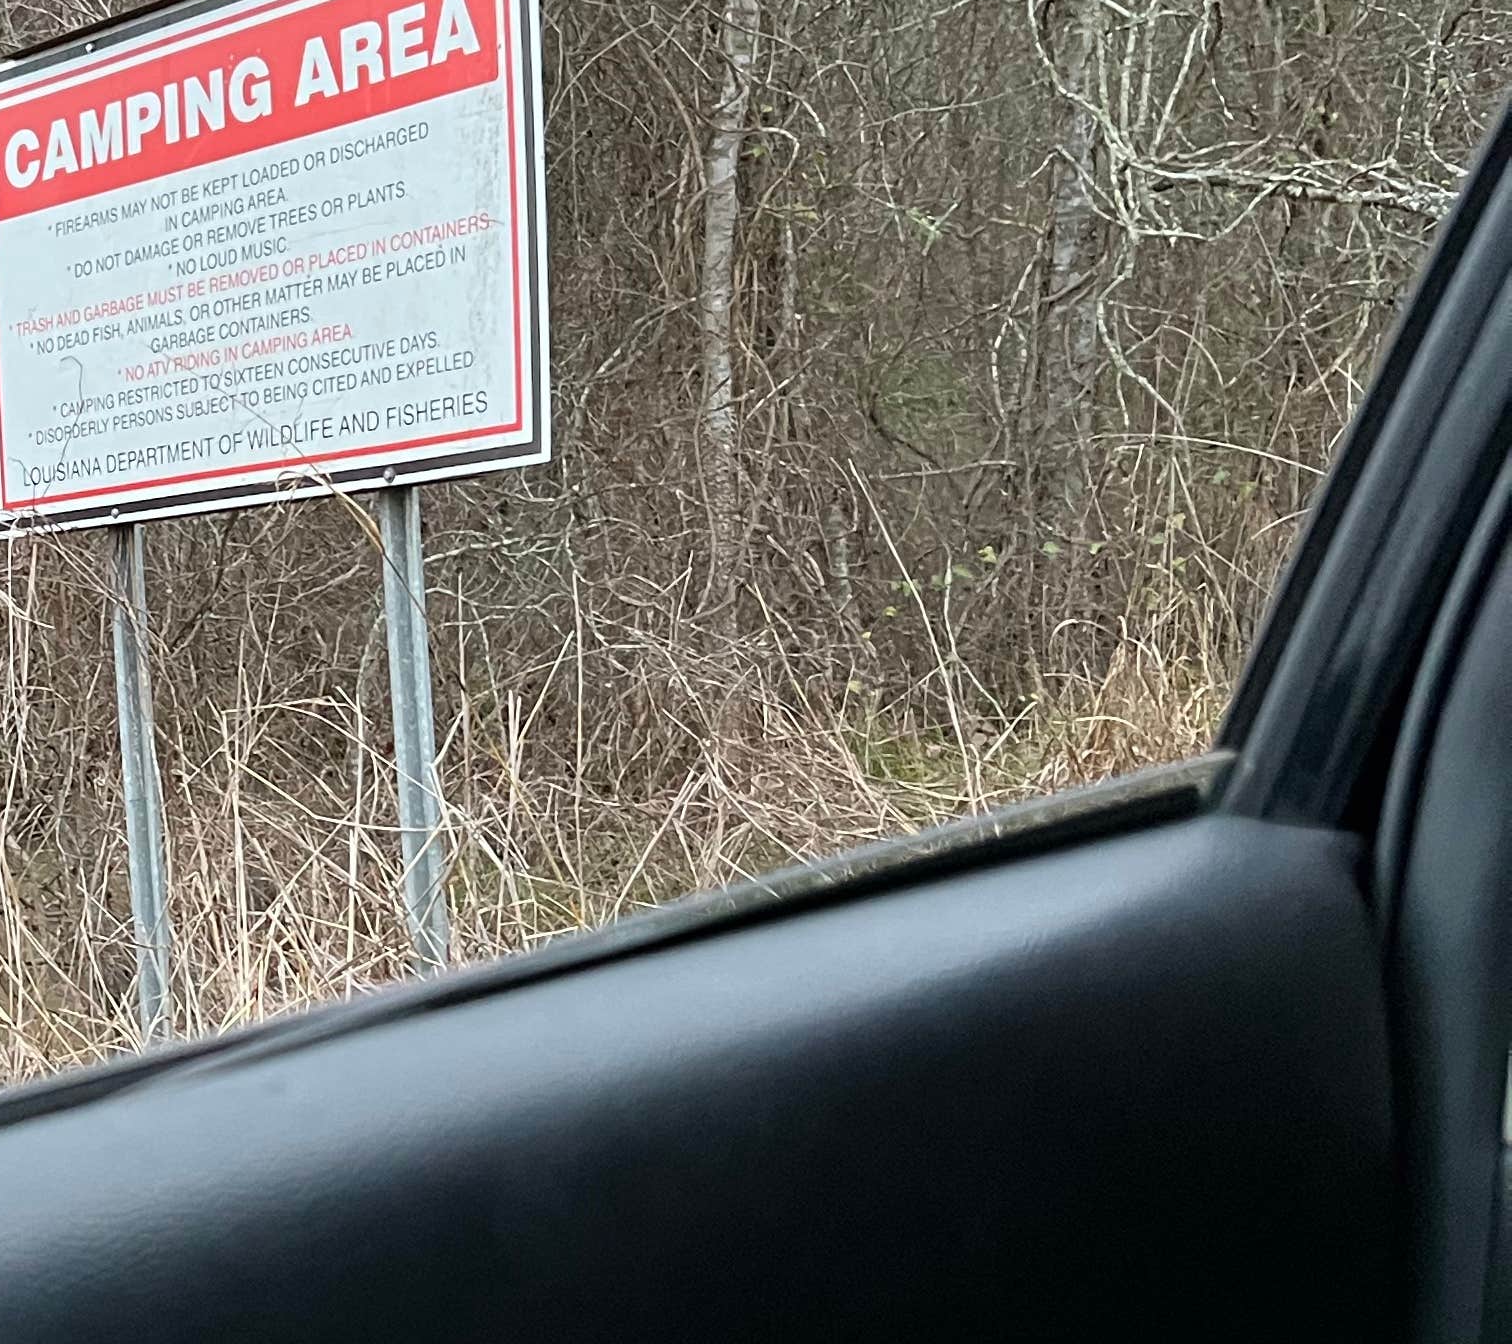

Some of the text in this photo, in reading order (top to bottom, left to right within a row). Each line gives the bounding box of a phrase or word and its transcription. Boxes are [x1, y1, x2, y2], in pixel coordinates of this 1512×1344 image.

[5, 56, 273, 189] CAMPING
[55, 121, 428, 237] FIREARMS MAY NOT BE KEPT LOADED OR DISCHARGED
[164, 216, 176, 232] IN
[180, 198, 243, 227] CAMPING
[73, 261, 92, 278] DO
[95, 254, 120, 273] NOT
[124, 239, 178, 266] DAMAGE
[182, 233, 202, 251] OR
[206, 217, 265, 245] REMOVE
[269, 203, 316, 229] TREES
[320, 197, 342, 216] OR
[176, 259, 195, 277] NO
[199, 249, 236, 271] LOUD
[16, 317, 52, 337] TRASH
[55, 310, 80, 328] AND
[83, 295, 142, 321] GARBAGE
[147, 286, 183, 306] MUST
[187, 281, 204, 297] BE
[208, 263, 277, 292] REMOVED
[281, 257, 304, 275] OR
[308, 242, 366, 269] PLACED
[371, 238, 385, 254] IN
[36, 245, 465, 355] NO DEAD FISH, ANIMALS, OR OTHER MATTER MAY BE PLACED IN
[59, 331, 439, 418] CAMPING RESTRICTED TO SIXTEEN CONSECUTIVE DAYS.
[125, 366, 143, 382] NO
[146, 360, 170, 377] ATV
[173, 350, 219, 372] RIDING
[224, 346, 237, 362] IN
[241, 332, 307, 358] CAMPING
[150, 327, 213, 354] GARBAGE
[22, 390, 487, 487] LOUISIANA DEPARTMENT OF WILDLIFE AND FISHERIES
[35, 419, 109, 445] DISORDERLY
[112, 407, 172, 431] PERSONS
[175, 395, 236, 419] SUBJECT
[240, 391, 258, 407] TO
[263, 382, 307, 403] BEING
[311, 372, 356, 394] CITED
[359, 366, 391, 386] AND
